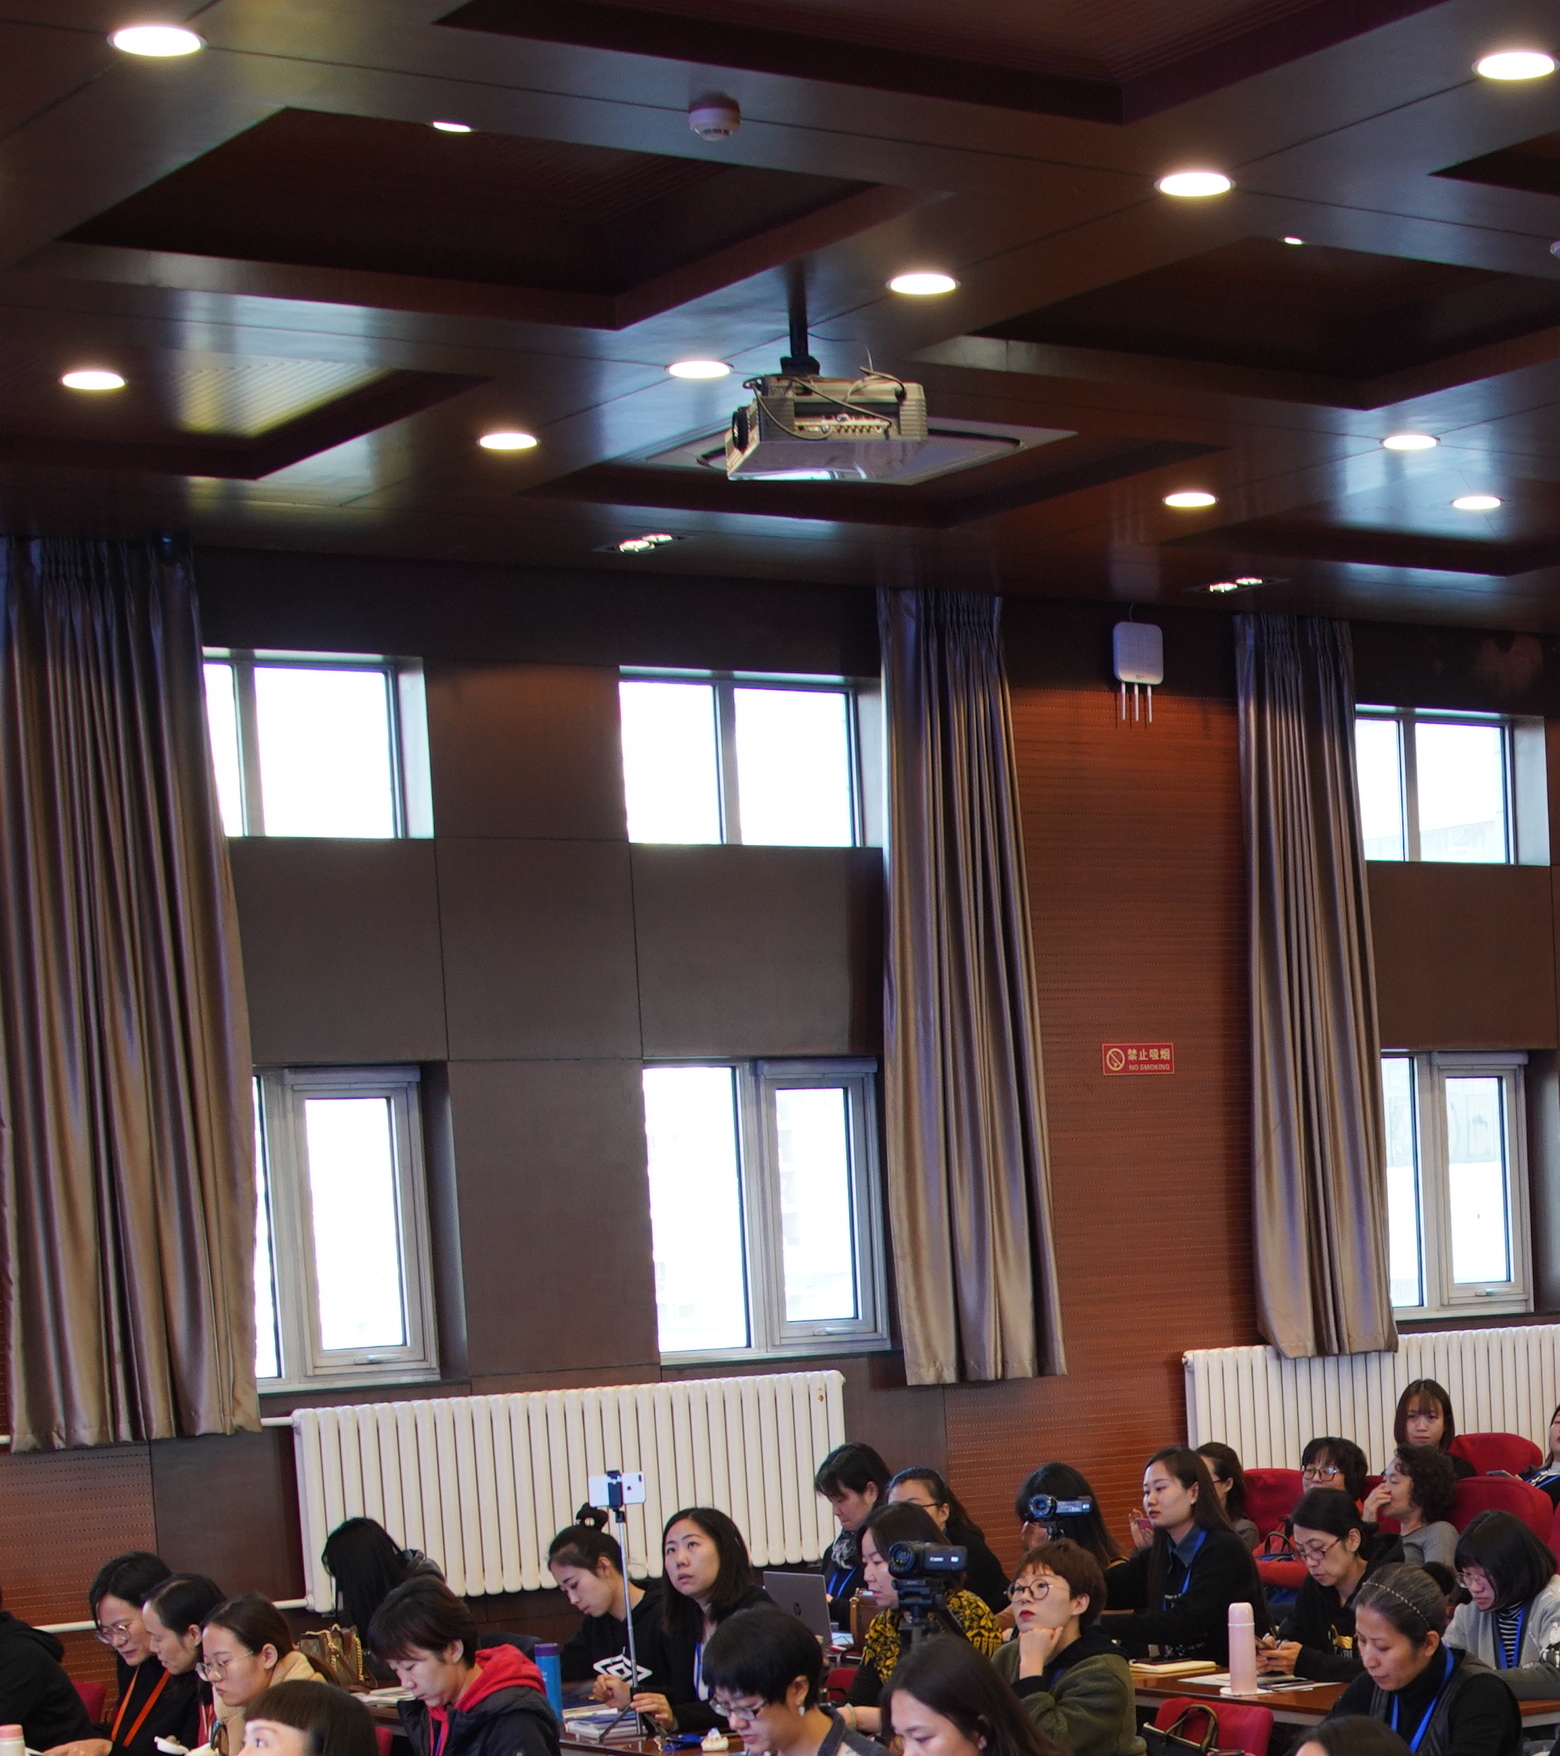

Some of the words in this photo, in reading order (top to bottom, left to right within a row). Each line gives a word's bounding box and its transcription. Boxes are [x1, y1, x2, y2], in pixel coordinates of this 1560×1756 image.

[1127, 1048, 1171, 1061] 禁止吸烟
[1140, 1063, 1171, 1071] SMOKING
